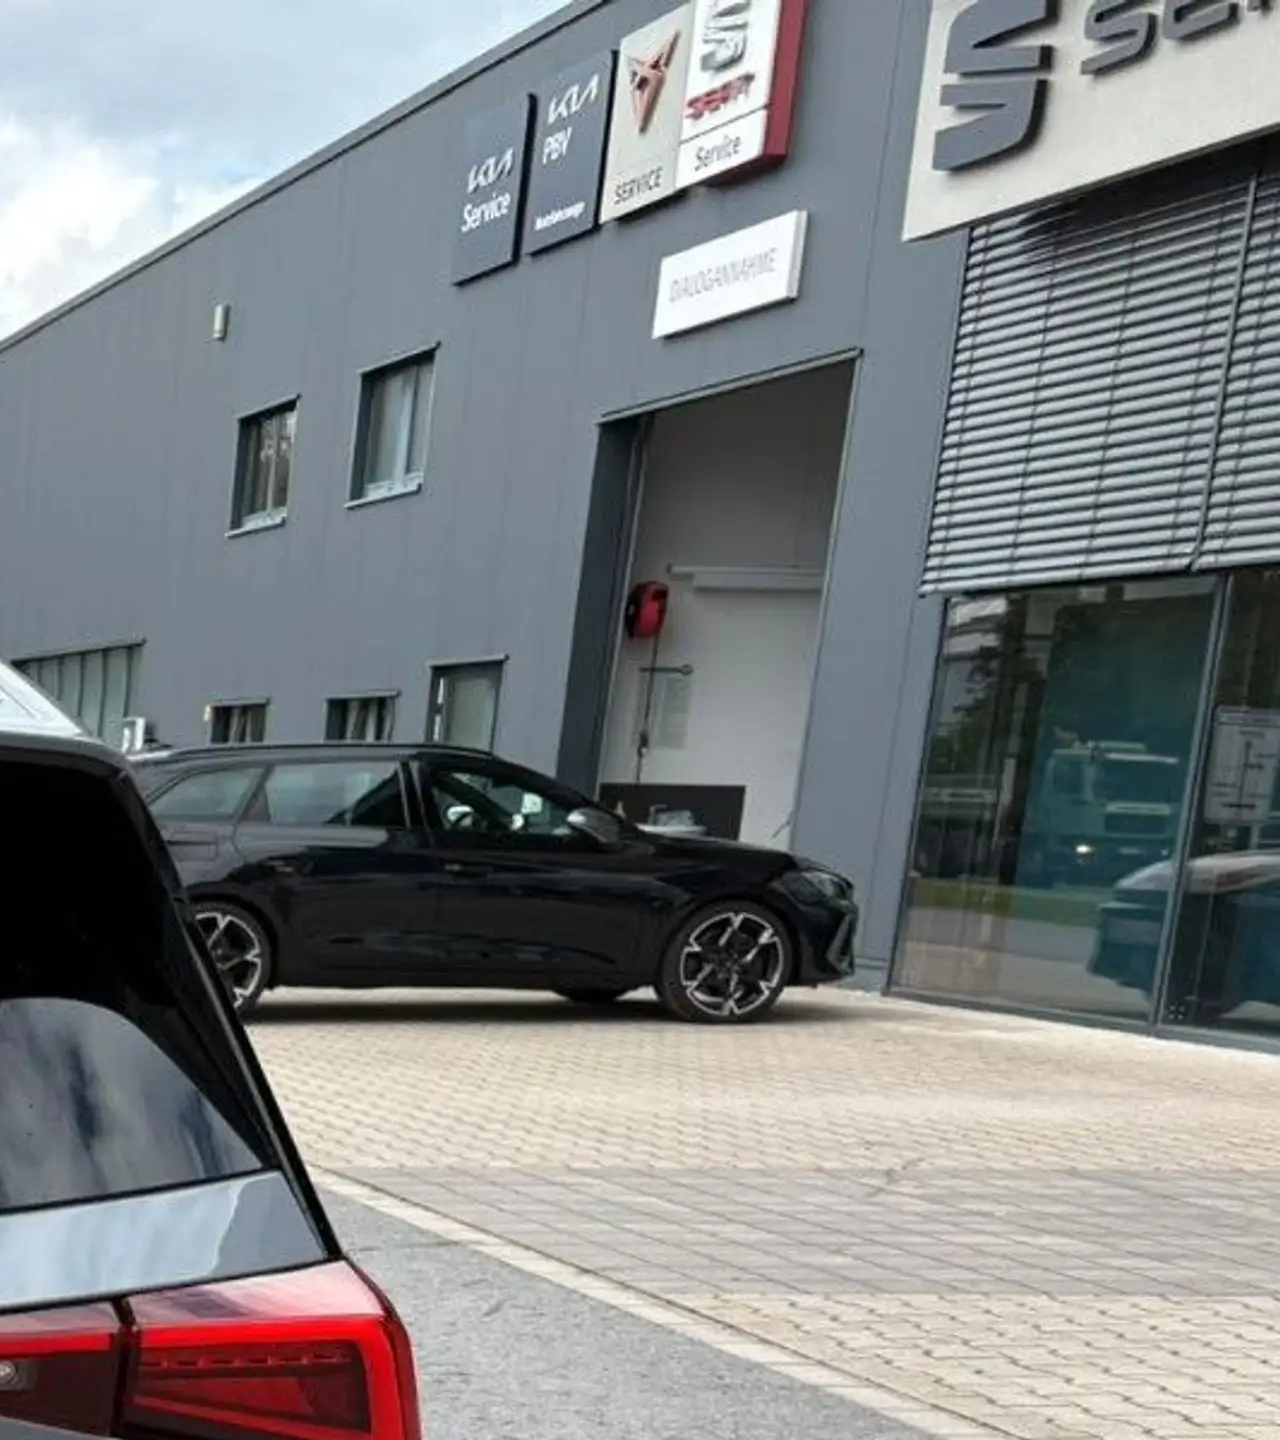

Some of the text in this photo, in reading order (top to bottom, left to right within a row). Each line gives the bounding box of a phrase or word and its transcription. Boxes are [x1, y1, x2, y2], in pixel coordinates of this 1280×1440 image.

[542, 126, 573, 165] PBV
[695, 135, 741, 172] Service
[614, 167, 663, 205] SERVICE
[461, 192, 511, 232] Service
